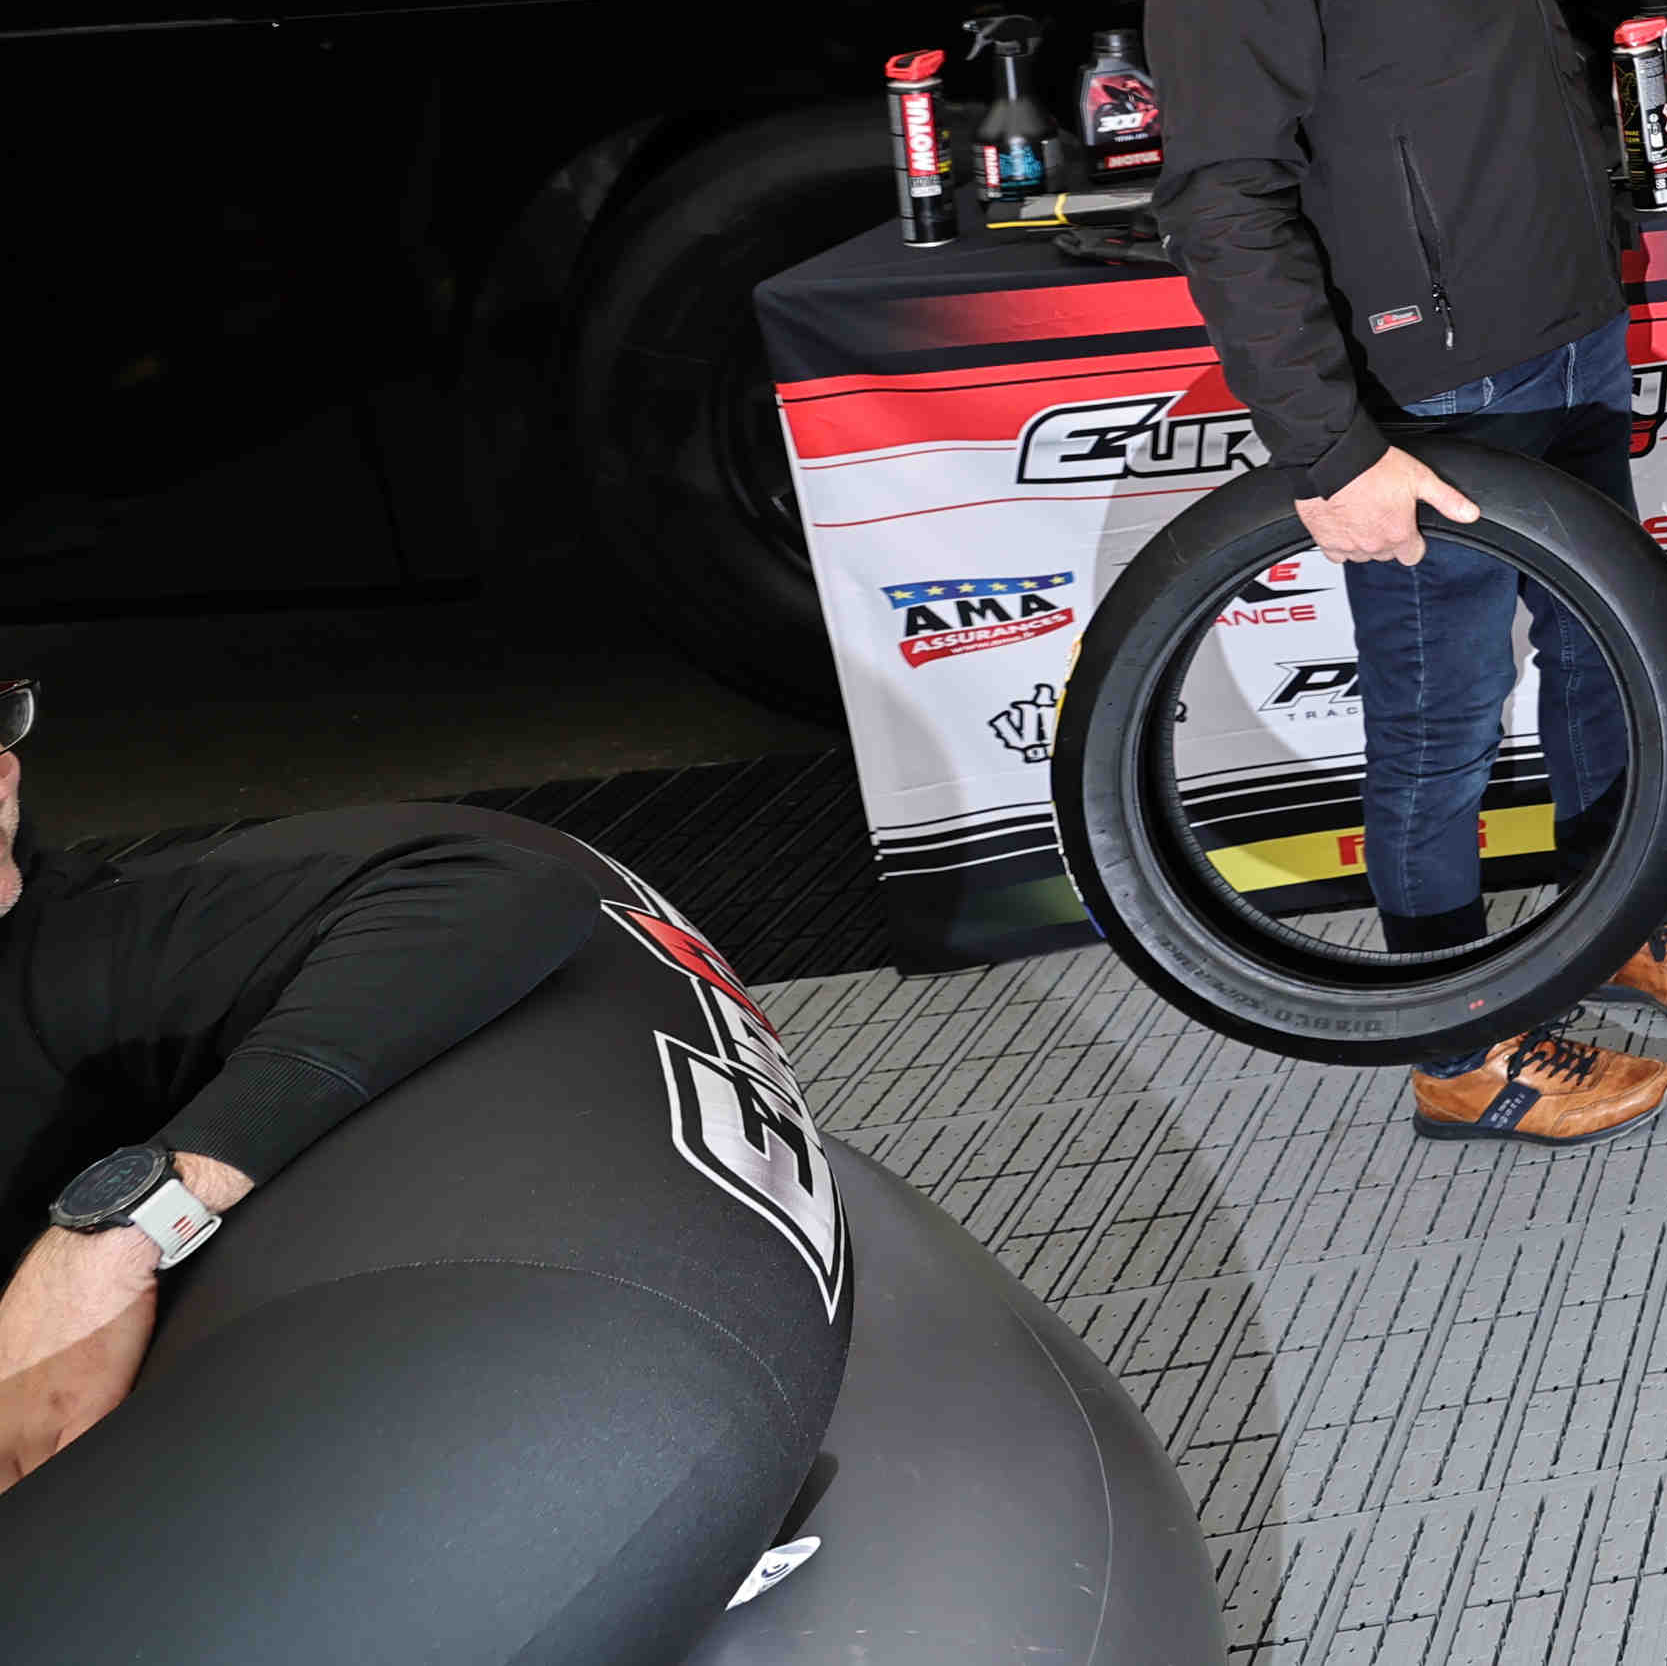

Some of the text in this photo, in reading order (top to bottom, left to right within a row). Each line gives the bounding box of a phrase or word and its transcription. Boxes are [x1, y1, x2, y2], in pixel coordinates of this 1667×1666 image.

[905, 97, 936, 172] MOTUL
[904, 593, 1059, 637] AMA
[911, 613, 1068, 655] ASSURANCES
